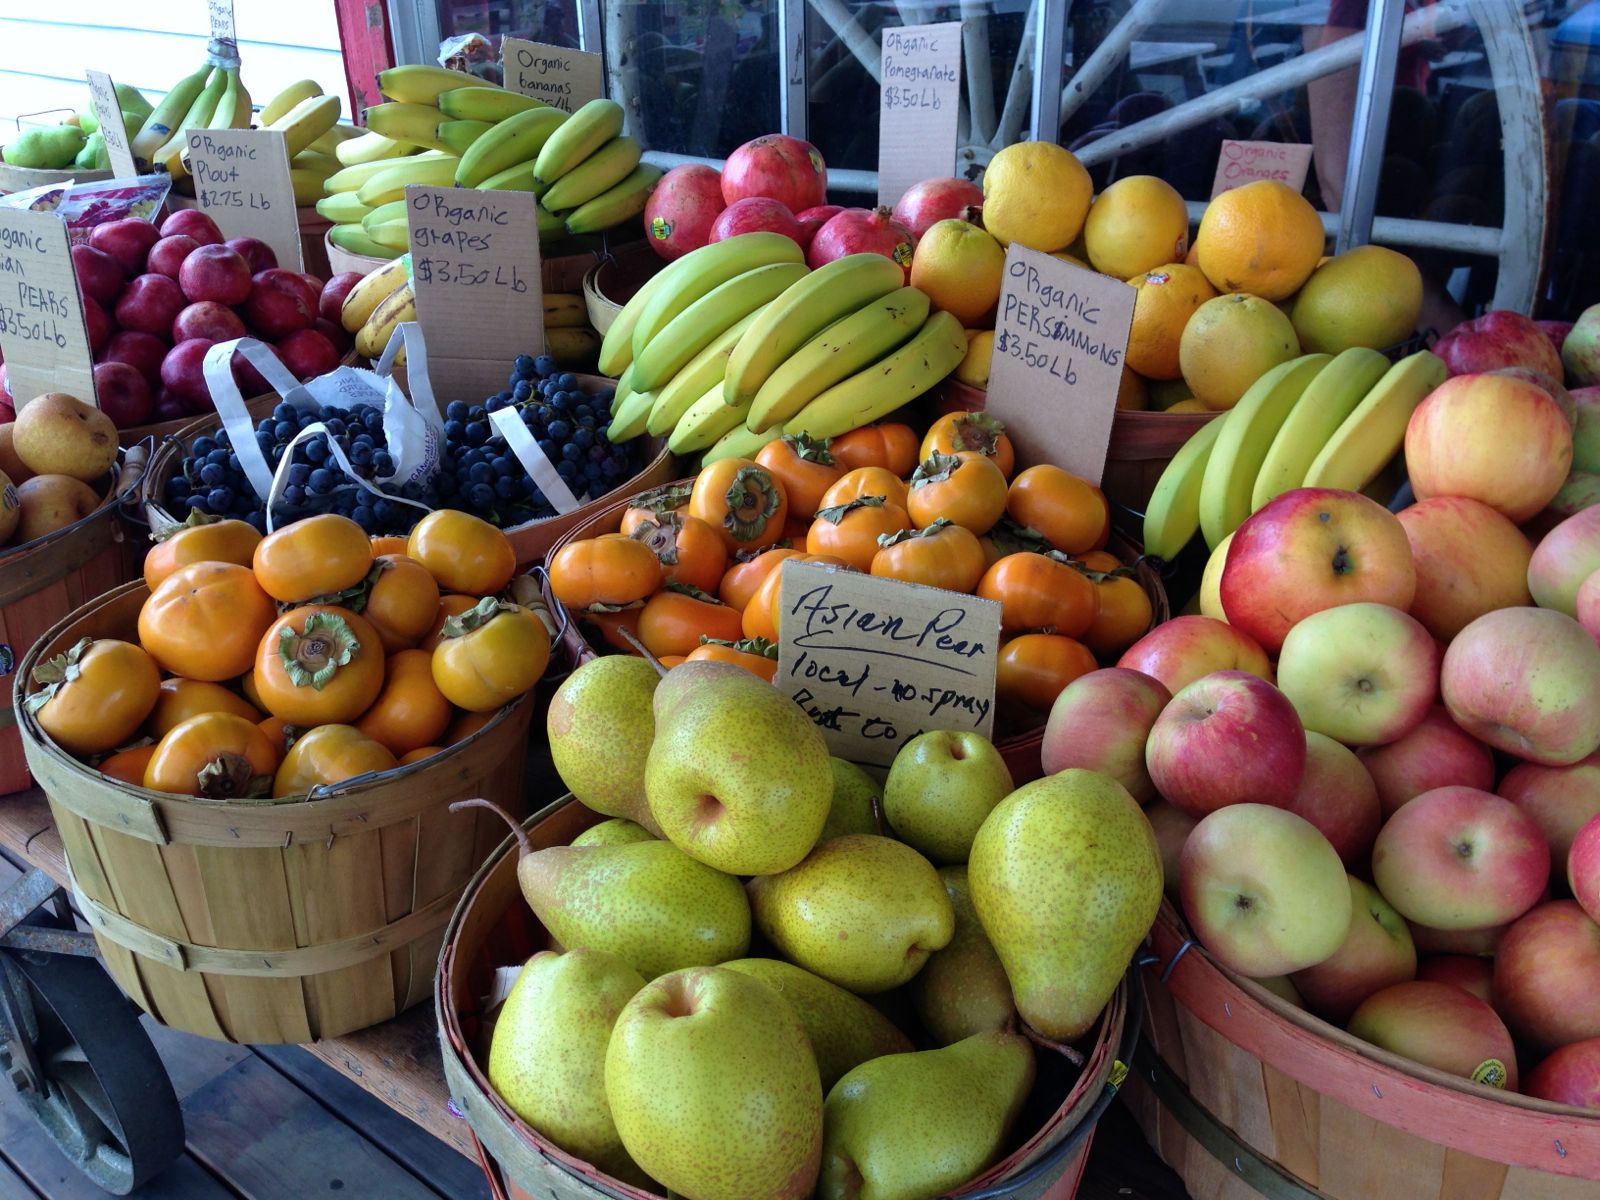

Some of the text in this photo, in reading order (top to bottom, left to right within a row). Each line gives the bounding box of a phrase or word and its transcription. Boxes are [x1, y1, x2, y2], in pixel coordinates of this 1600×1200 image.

[517, 50, 571, 74] Organic
[885, 56, 956, 82] Pomegranate
[519, 72, 572, 94] bananas
[1224, 142, 1286, 164] Organic
[1223, 162, 1289, 180] Oranges
[250, 192, 271, 210] Lb
[415, 227, 492, 253] grapes
[18, 282, 68, 318] PEARS
[792, 584, 919, 639] Asian
[791, 651, 869, 697] local
